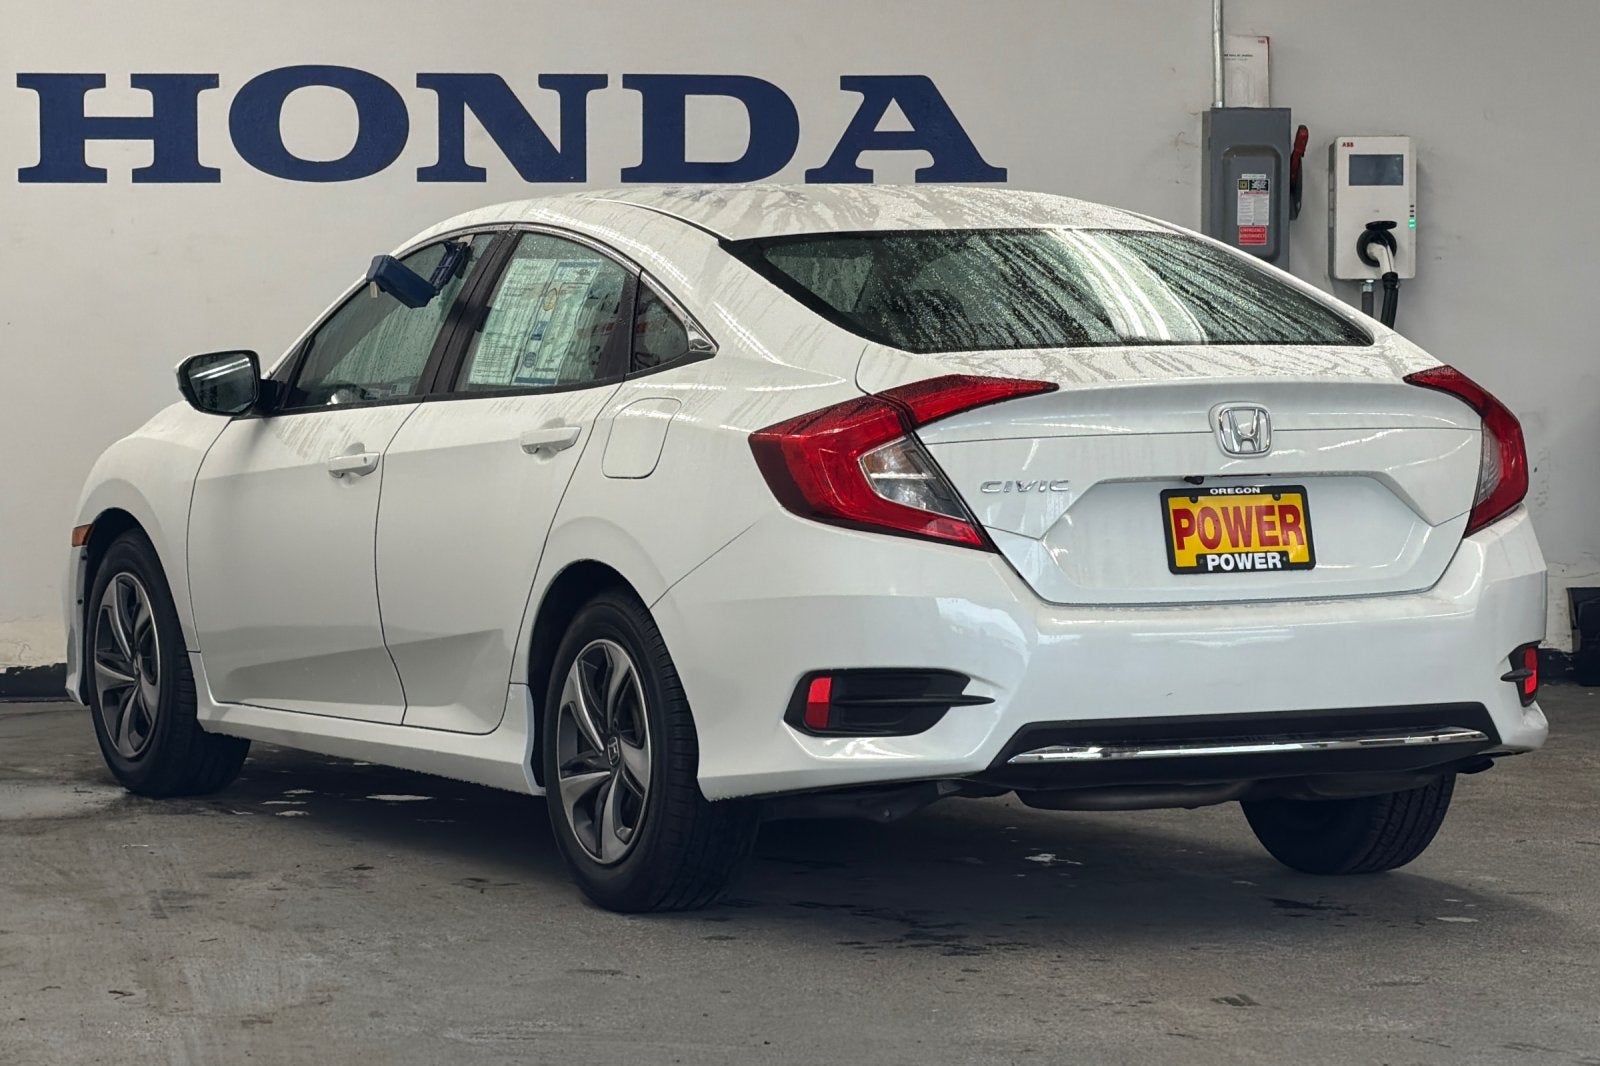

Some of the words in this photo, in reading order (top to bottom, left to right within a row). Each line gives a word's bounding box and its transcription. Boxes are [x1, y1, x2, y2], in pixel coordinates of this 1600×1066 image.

[18, 66, 1006, 183] HONDA
[981, 480, 1069, 493] CIVIC
[1210, 487, 1261, 495] OREGON
[1172, 504, 1305, 551] POWER
[1206, 552, 1282, 571] POWER
